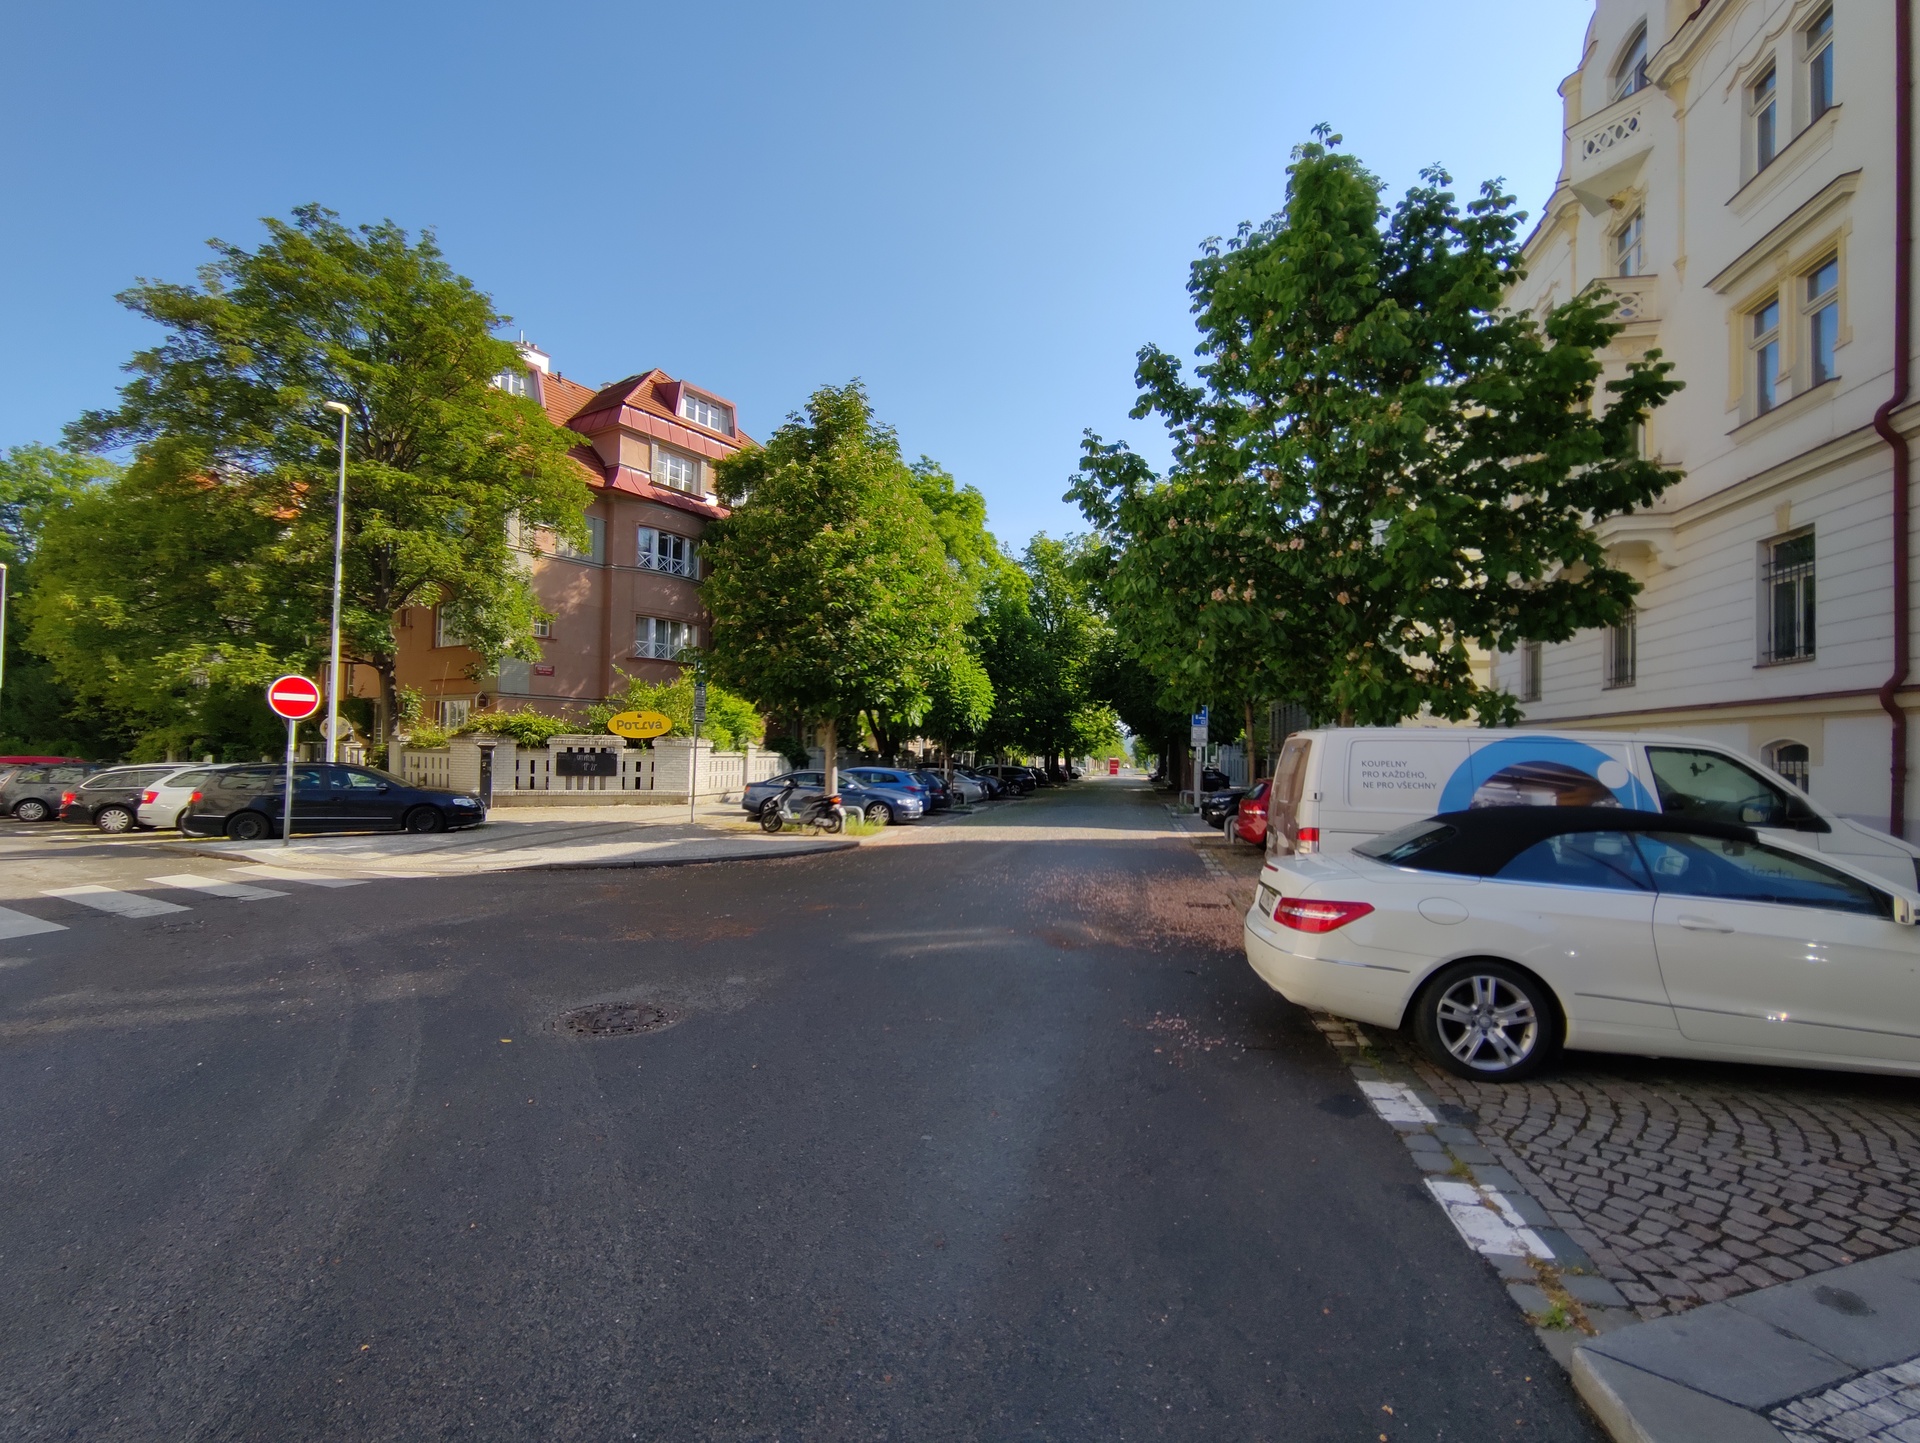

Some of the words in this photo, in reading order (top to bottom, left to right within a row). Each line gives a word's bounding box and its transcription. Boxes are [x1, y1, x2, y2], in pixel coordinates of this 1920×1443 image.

[1362, 770, 1380, 778] PRO
[1382, 770, 1427, 780] KAŽDÉHO,
[1362, 781, 1374, 789] NE
[1376, 781, 1395, 789] PRO
[1396, 780, 1437, 789] VŠECHNY
